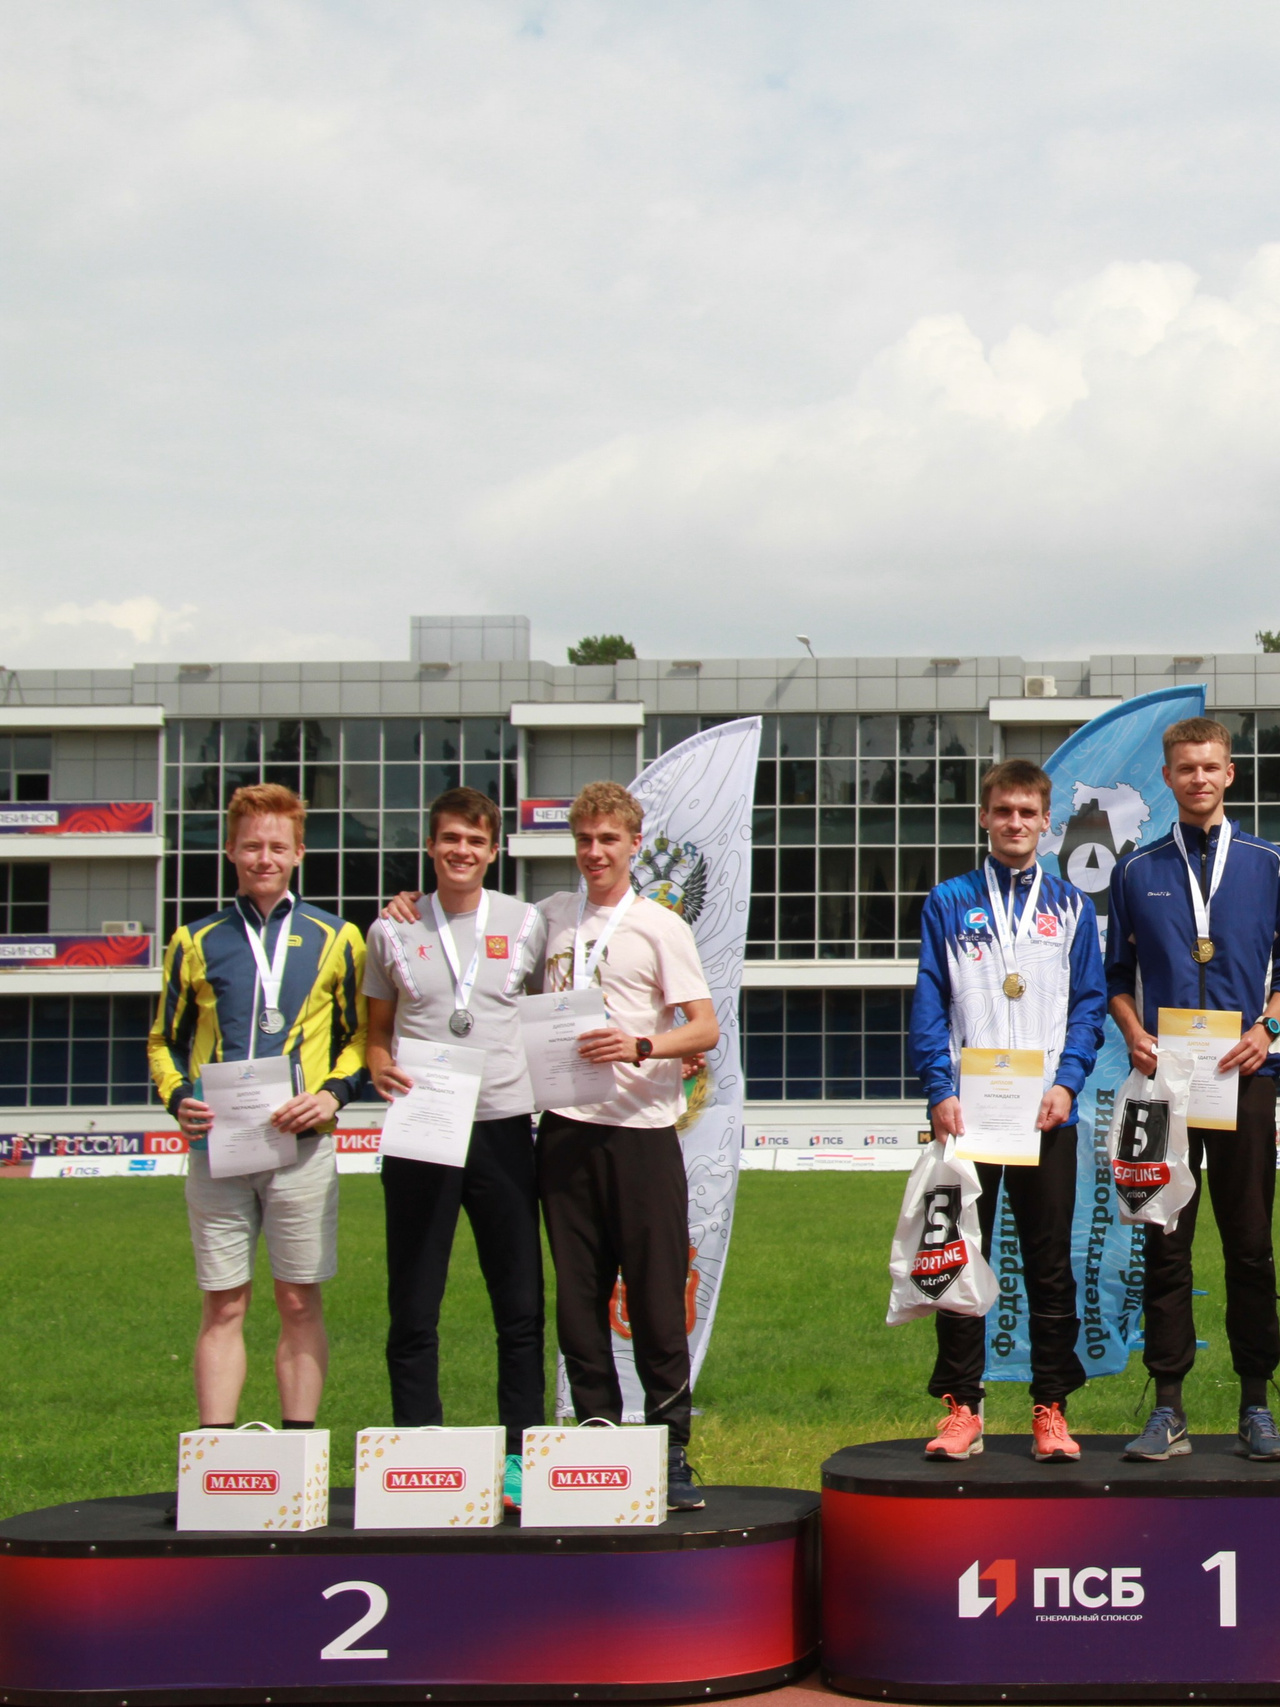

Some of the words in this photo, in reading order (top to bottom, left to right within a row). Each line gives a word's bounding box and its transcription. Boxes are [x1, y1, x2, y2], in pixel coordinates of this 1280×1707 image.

[151, 1137, 183, 1152] ПО
[768, 1137, 789, 1145] ПСБ
[822, 1137, 844, 1145] ПСБ
[877, 1136, 898, 1145] ПСБ
[991, 1182, 1024, 1357] Федераци
[210, 1476, 272, 1489] MAKFA
[391, 1474, 458, 1487] MAKFA
[556, 1472, 623, 1485] MAKFA
[1033, 1567, 1146, 1609] ПСБ
[1201, 1550, 1237, 1627] 1
[320, 1580, 389, 1660] 2
[1035, 1613, 1099, 1622] ГЕНЕРАЛЬНЫЙ
[1100, 1613, 1143, 1622] СПОНСОР
